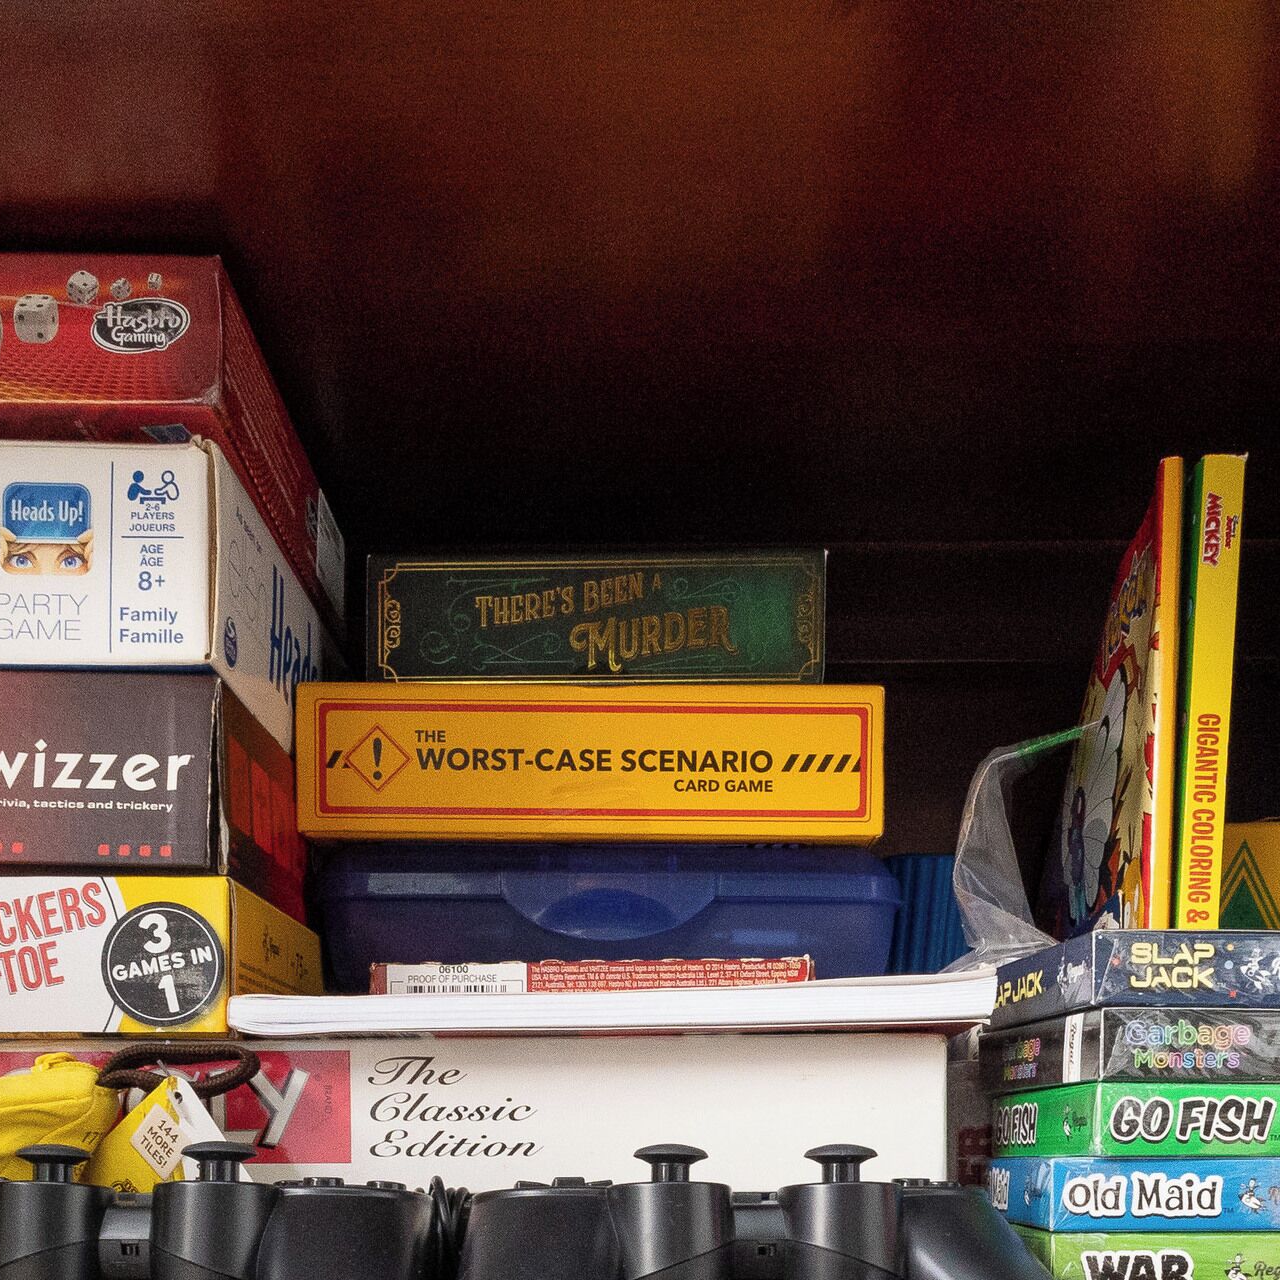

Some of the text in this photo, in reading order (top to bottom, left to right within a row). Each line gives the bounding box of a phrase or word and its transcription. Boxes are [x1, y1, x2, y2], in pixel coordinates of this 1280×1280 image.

[128, 522, 176, 533] JOUEURS
[1202, 491, 1223, 568] MICKEY
[475, 571, 662, 628] THERE'S BEEN A
[119, 606, 178, 626] Family
[119, 628, 184, 644] Famille
[569, 606, 739, 672] MURDER
[415, 730, 447, 743] THE
[416, 747, 774, 774] WORST-CASE SCENARIO
[674, 779, 773, 794] CARD GAME
[34, 798, 84, 809] tactics
[87, 799, 113, 810] and
[116, 800, 174, 814] trickery
[1130, 942, 1216, 966] SLAP
[408, 974, 497, 983] PROOF OF PURCHASE
[1129, 966, 1217, 989] JACK
[1124, 1018, 1252, 1050] Garbage
[366, 1055, 468, 1087] The
[1133, 1049, 1240, 1069] Monsters
[369, 1091, 538, 1123] Classic
[1111, 1097, 1172, 1141] GO
[1175, 1097, 1275, 1141] FISH
[369, 1129, 544, 1160] Edition
[1068, 1177, 1218, 1212] Old Maid
